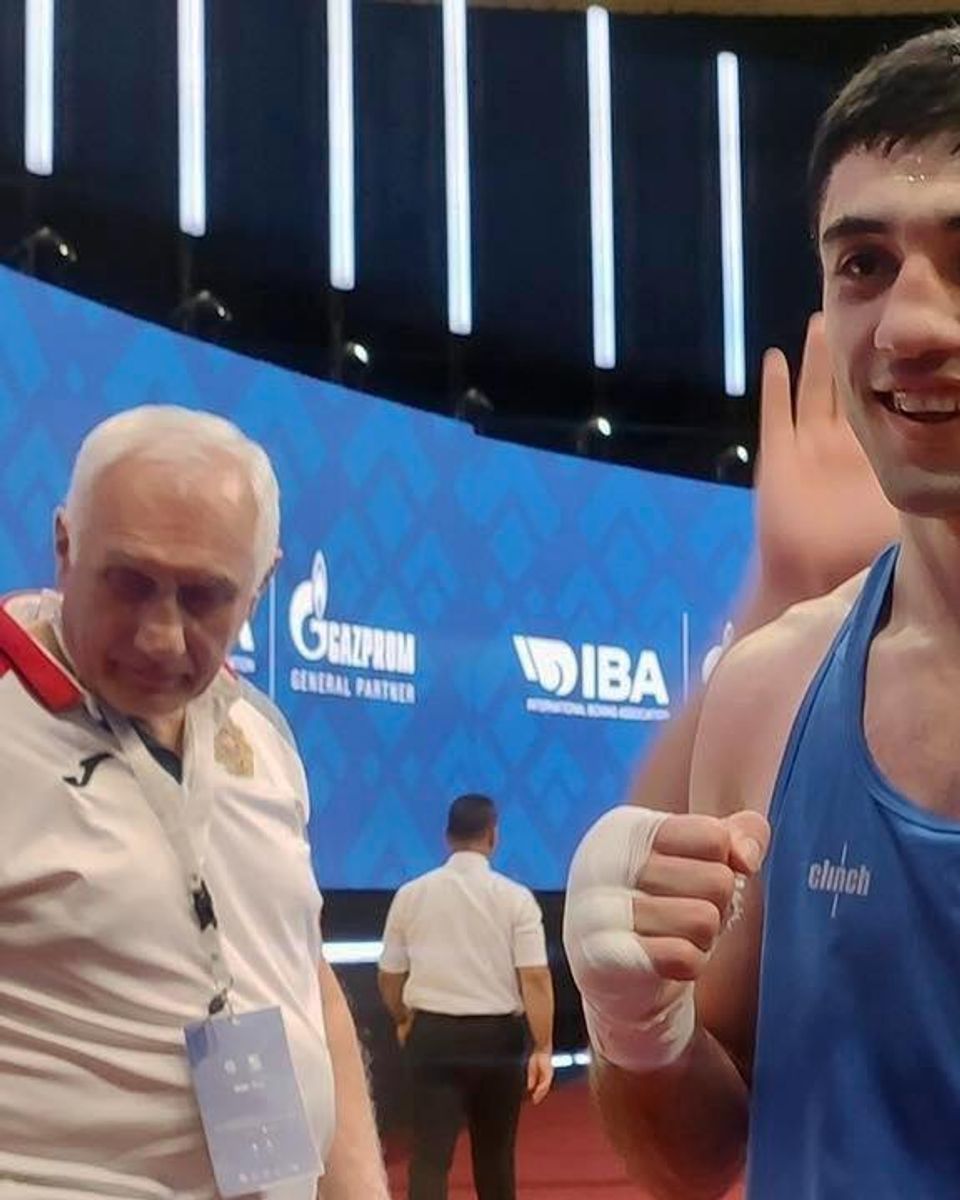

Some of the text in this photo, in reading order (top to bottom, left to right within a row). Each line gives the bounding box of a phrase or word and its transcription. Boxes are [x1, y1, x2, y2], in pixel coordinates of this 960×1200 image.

[328, 619, 415, 675] GAZPROM
[290, 667, 416, 704] GENERAL PARTNER
[581, 643, 670, 705] IBA
[808, 859, 870, 896] clinch
